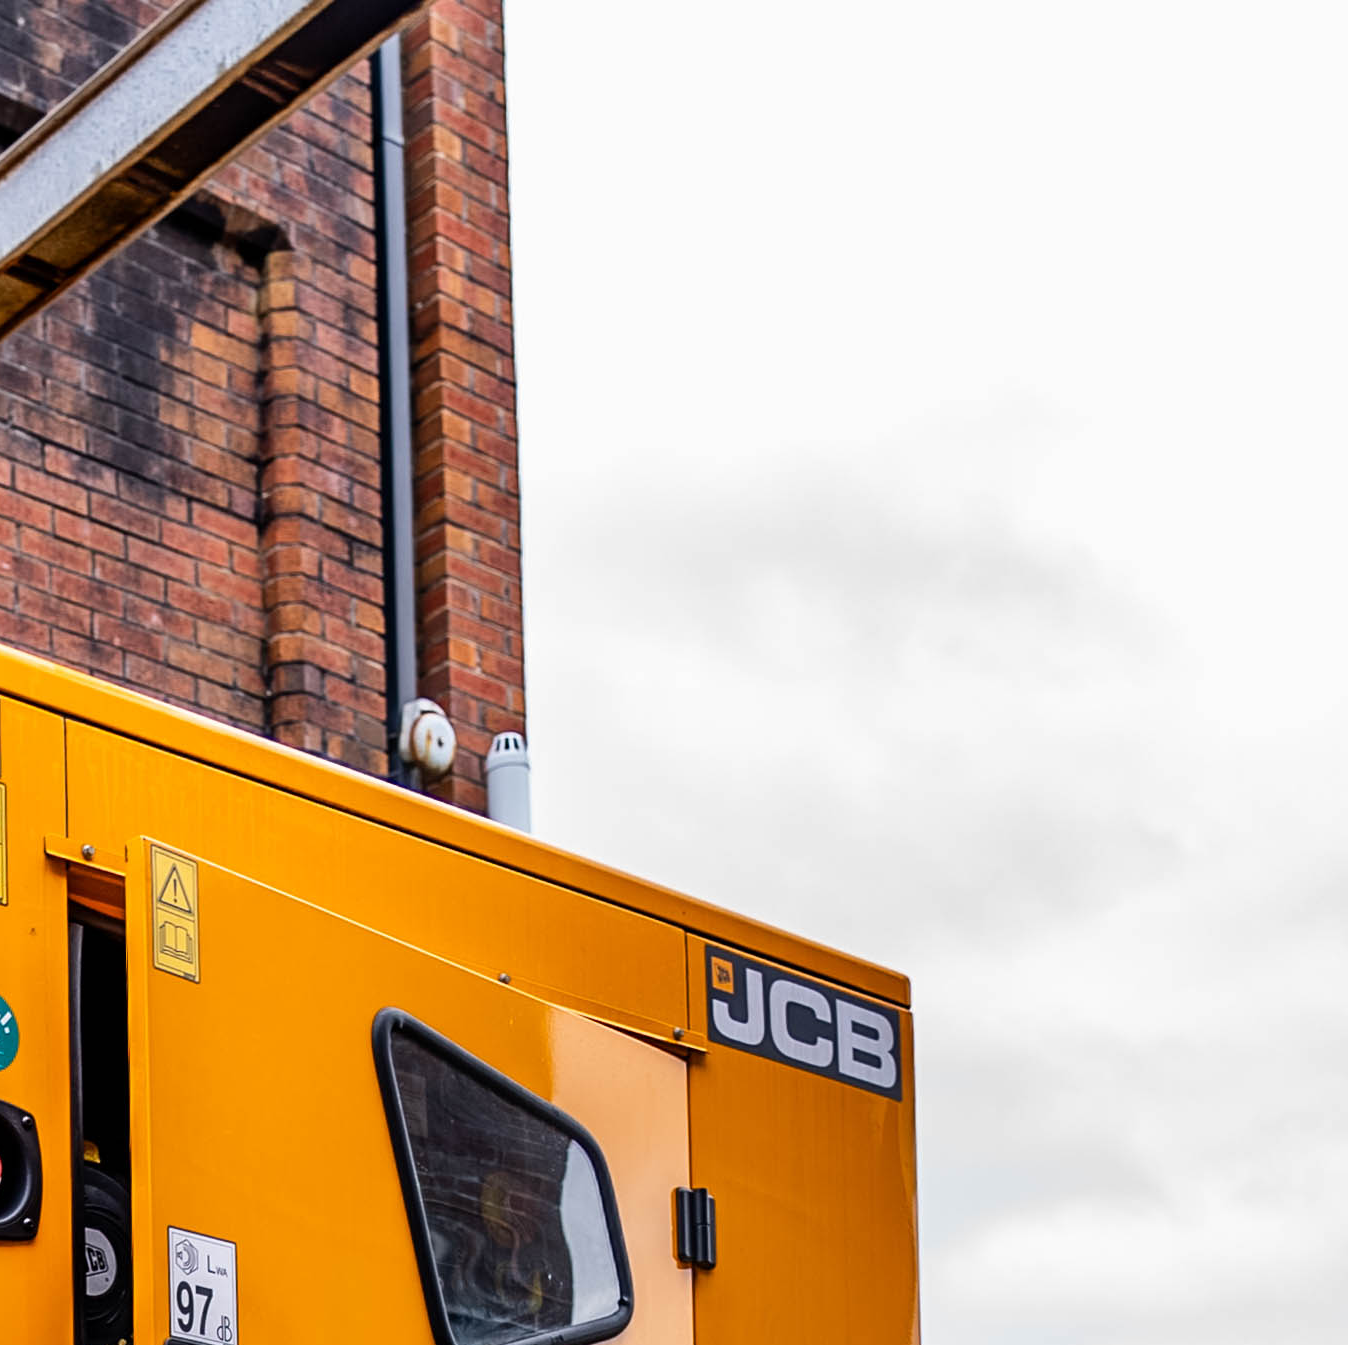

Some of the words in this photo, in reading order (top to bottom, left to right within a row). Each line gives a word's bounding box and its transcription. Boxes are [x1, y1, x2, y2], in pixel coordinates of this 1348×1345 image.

[712, 967, 897, 1089] JCB
[176, 1280, 213, 1335] 97
[216, 1315, 232, 1342] dB
